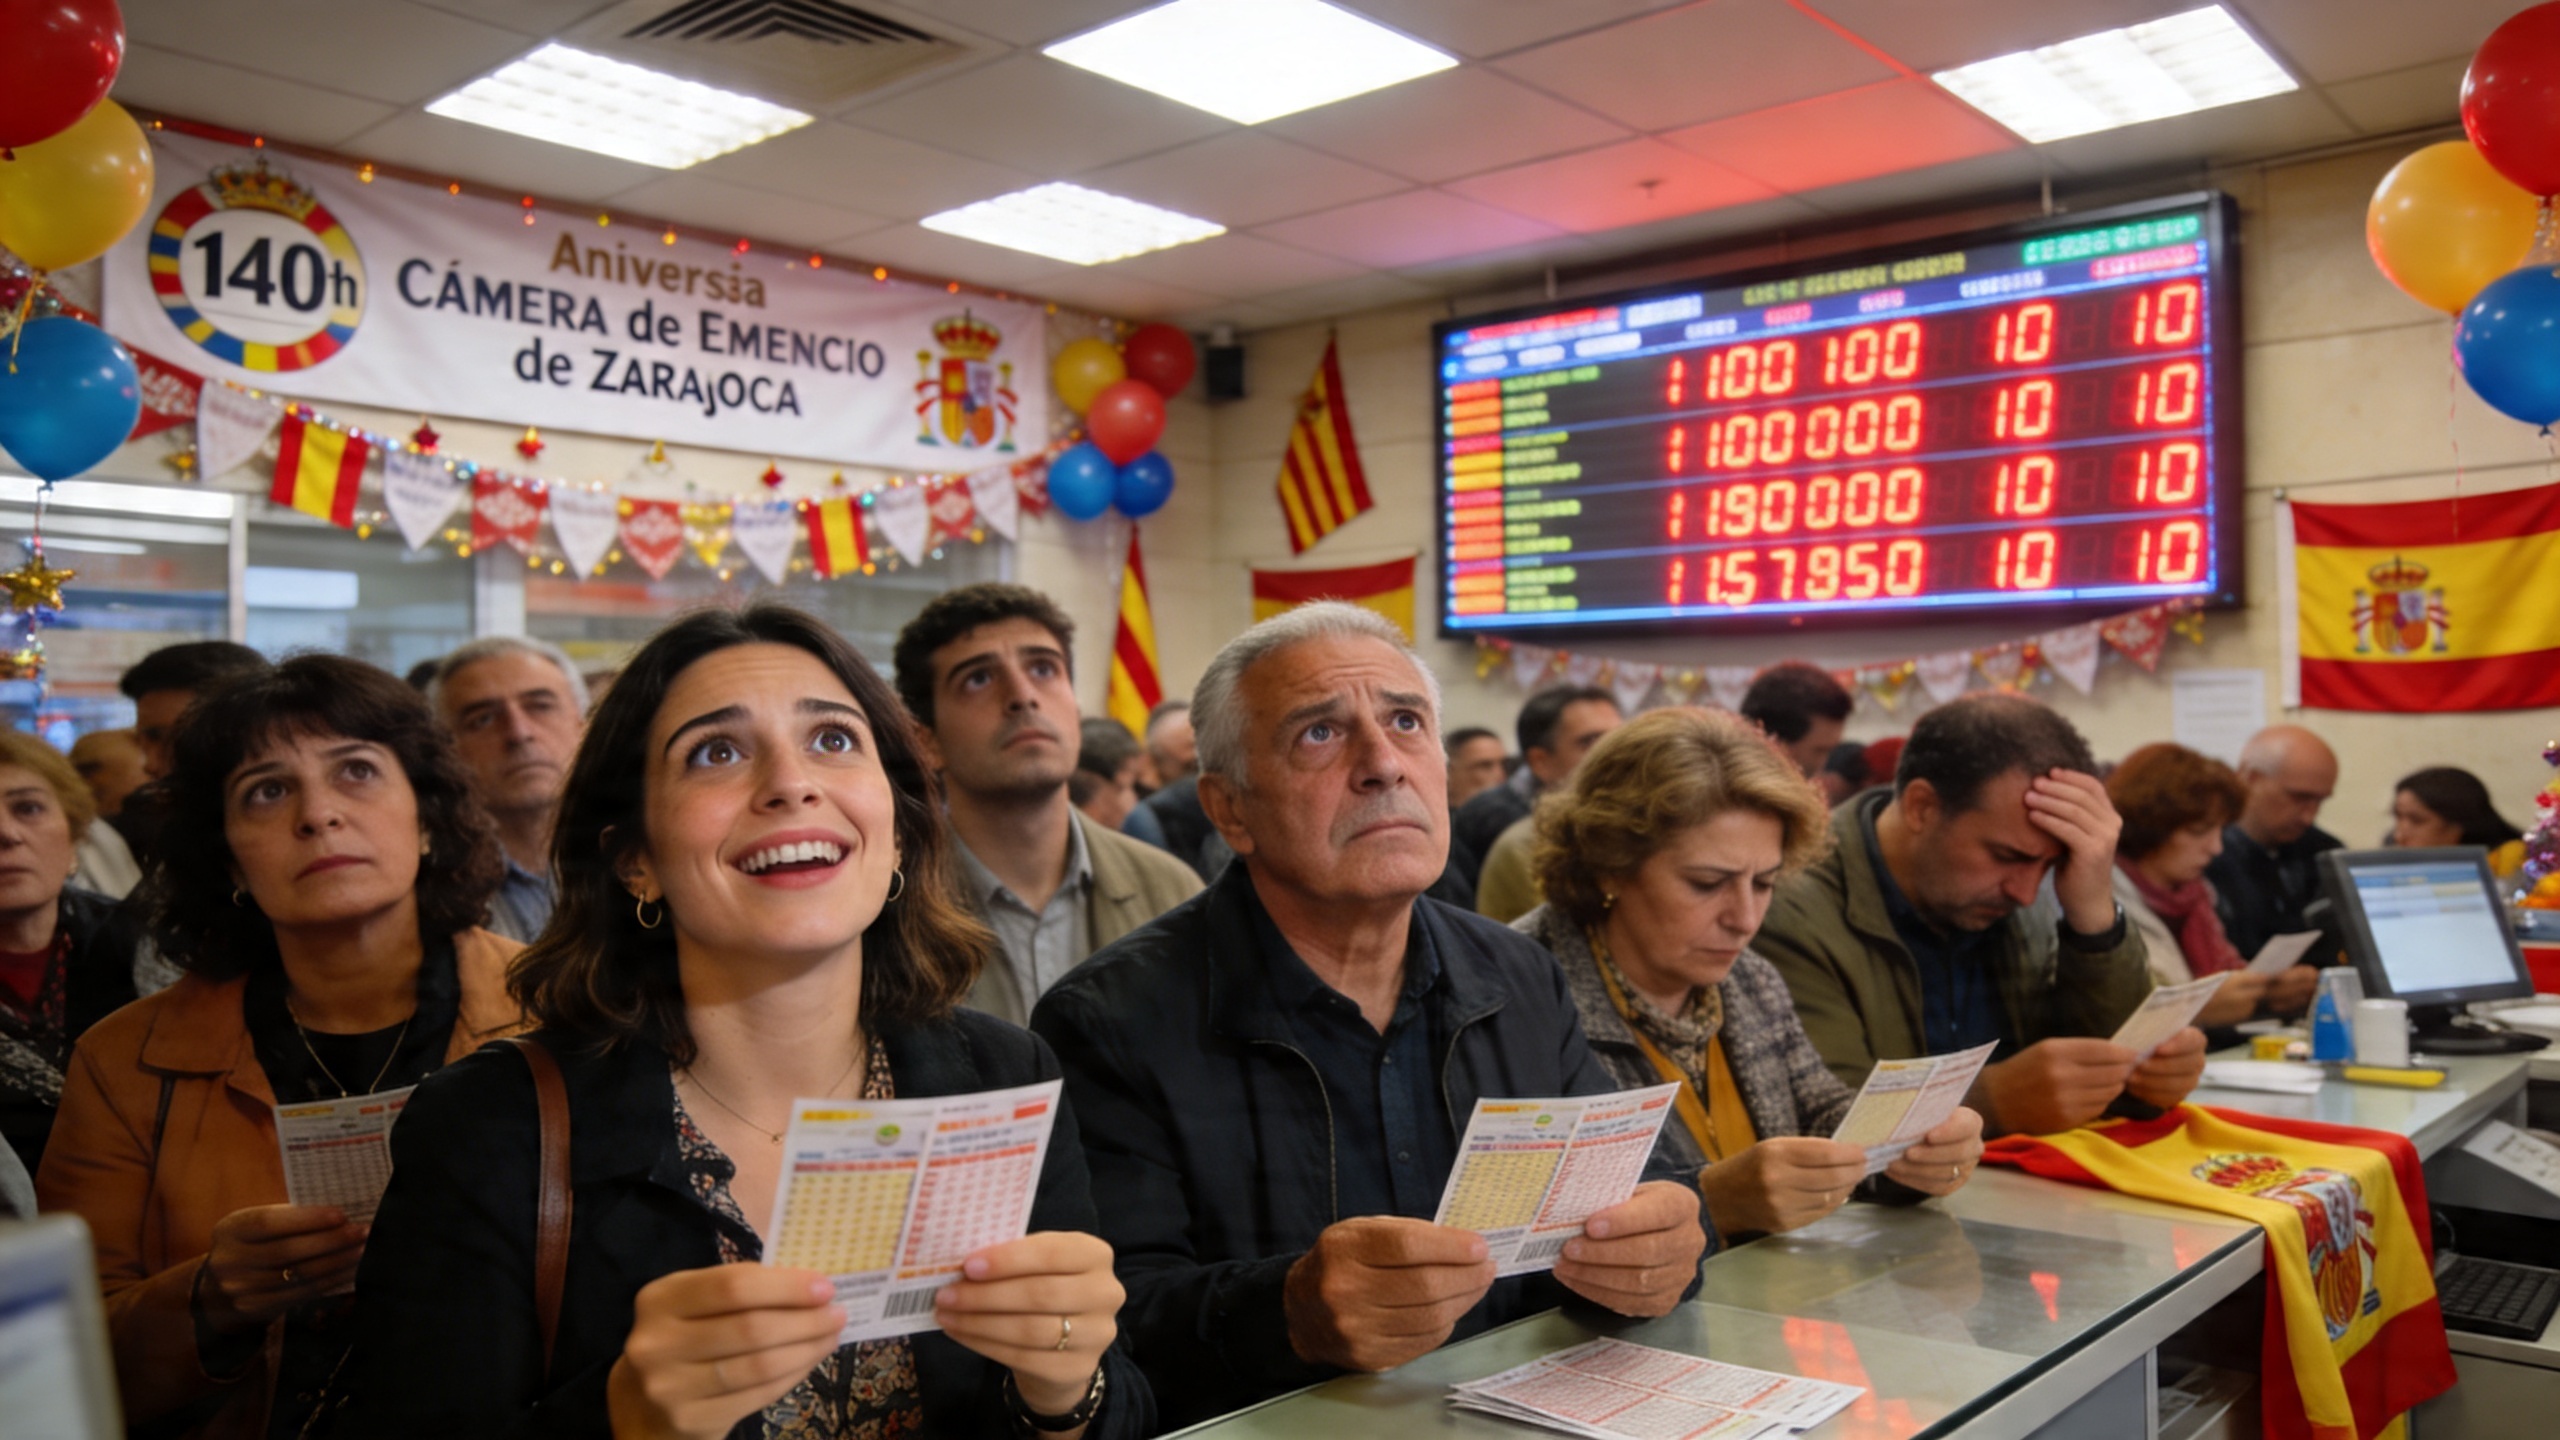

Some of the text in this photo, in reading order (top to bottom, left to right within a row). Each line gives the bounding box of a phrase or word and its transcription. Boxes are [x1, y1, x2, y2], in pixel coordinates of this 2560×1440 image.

[397, 257, 885, 378] CÁMERA de EMENCIO
[1995, 304, 2053, 363] 10
[2133, 284, 2198, 345] 10
[514, 336, 572, 386] de
[1995, 379, 2053, 439] 10
[2135, 363, 2199, 425] 10
[1995, 455, 2055, 515] 10
[2136, 443, 2199, 503] 10
[1996, 530, 2055, 589] 10
[2137, 521, 2200, 583] 10
